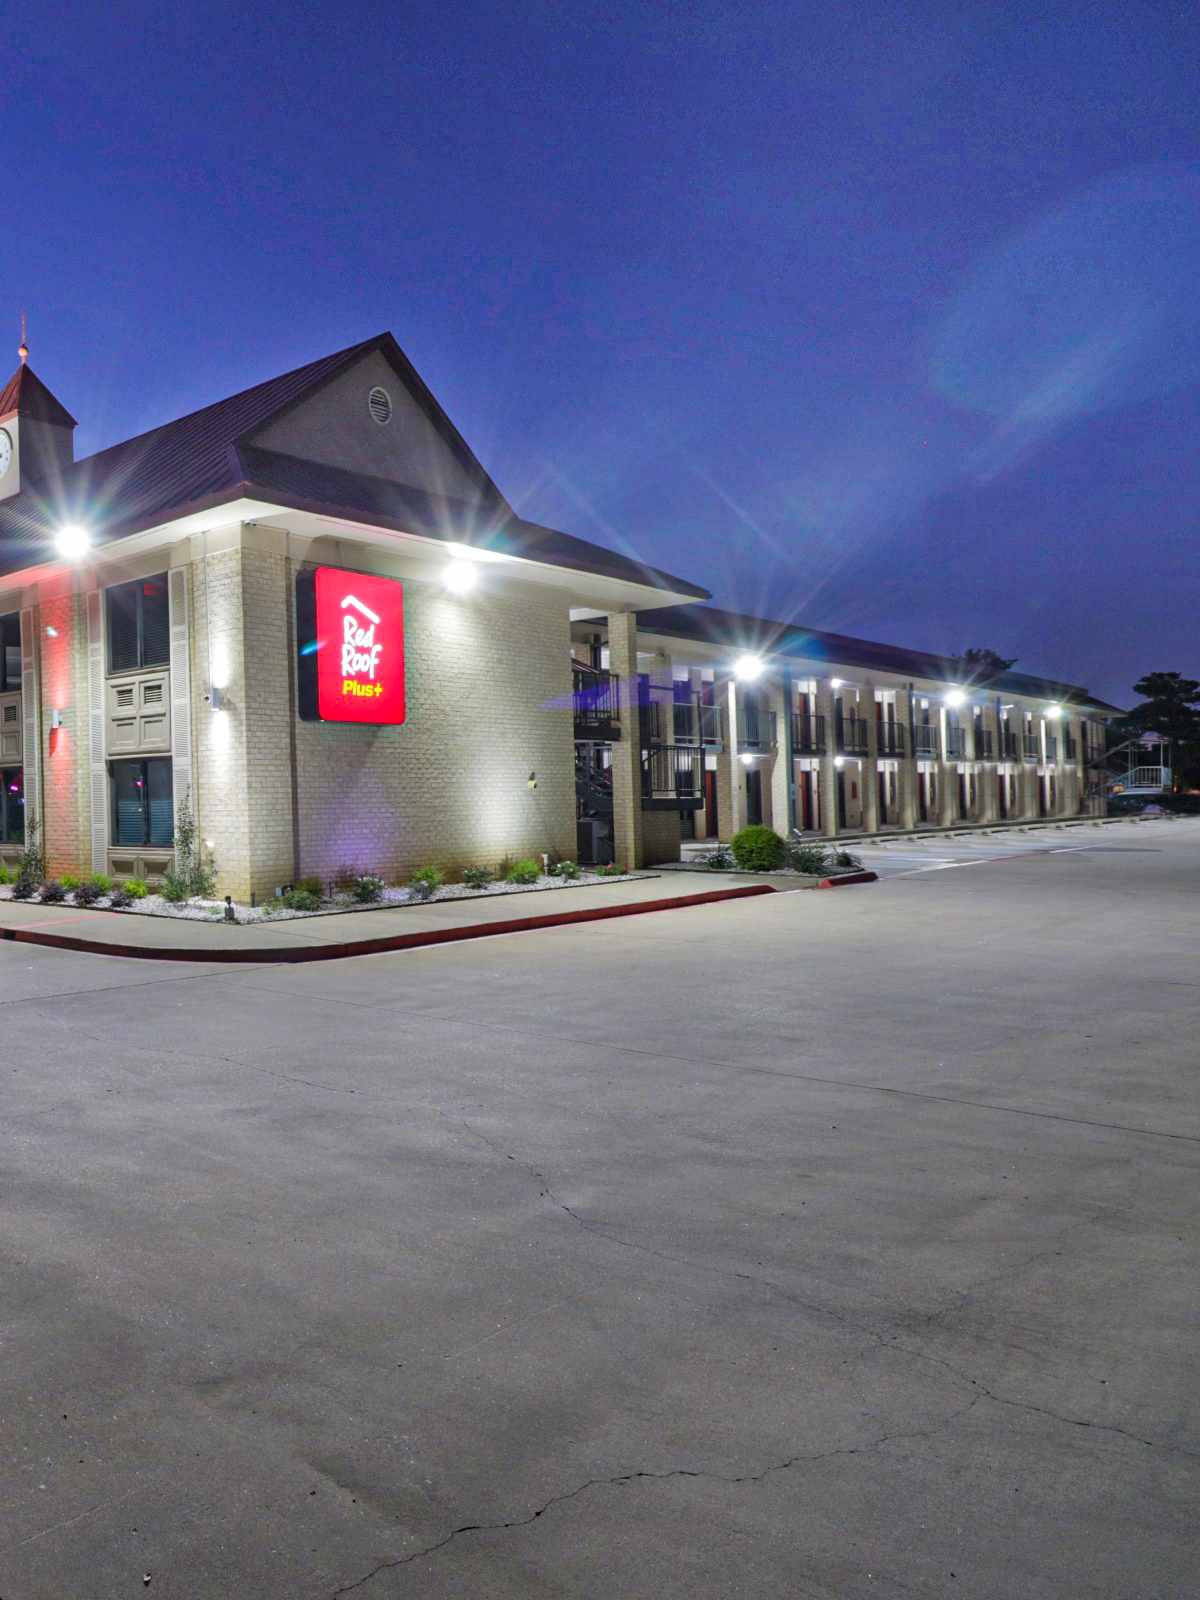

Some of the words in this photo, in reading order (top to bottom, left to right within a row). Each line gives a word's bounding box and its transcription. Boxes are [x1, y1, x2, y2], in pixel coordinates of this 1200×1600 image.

[343, 615, 375, 648] Red
[341, 643, 382, 679] Roof
[342, 680, 382, 697] Plus+
